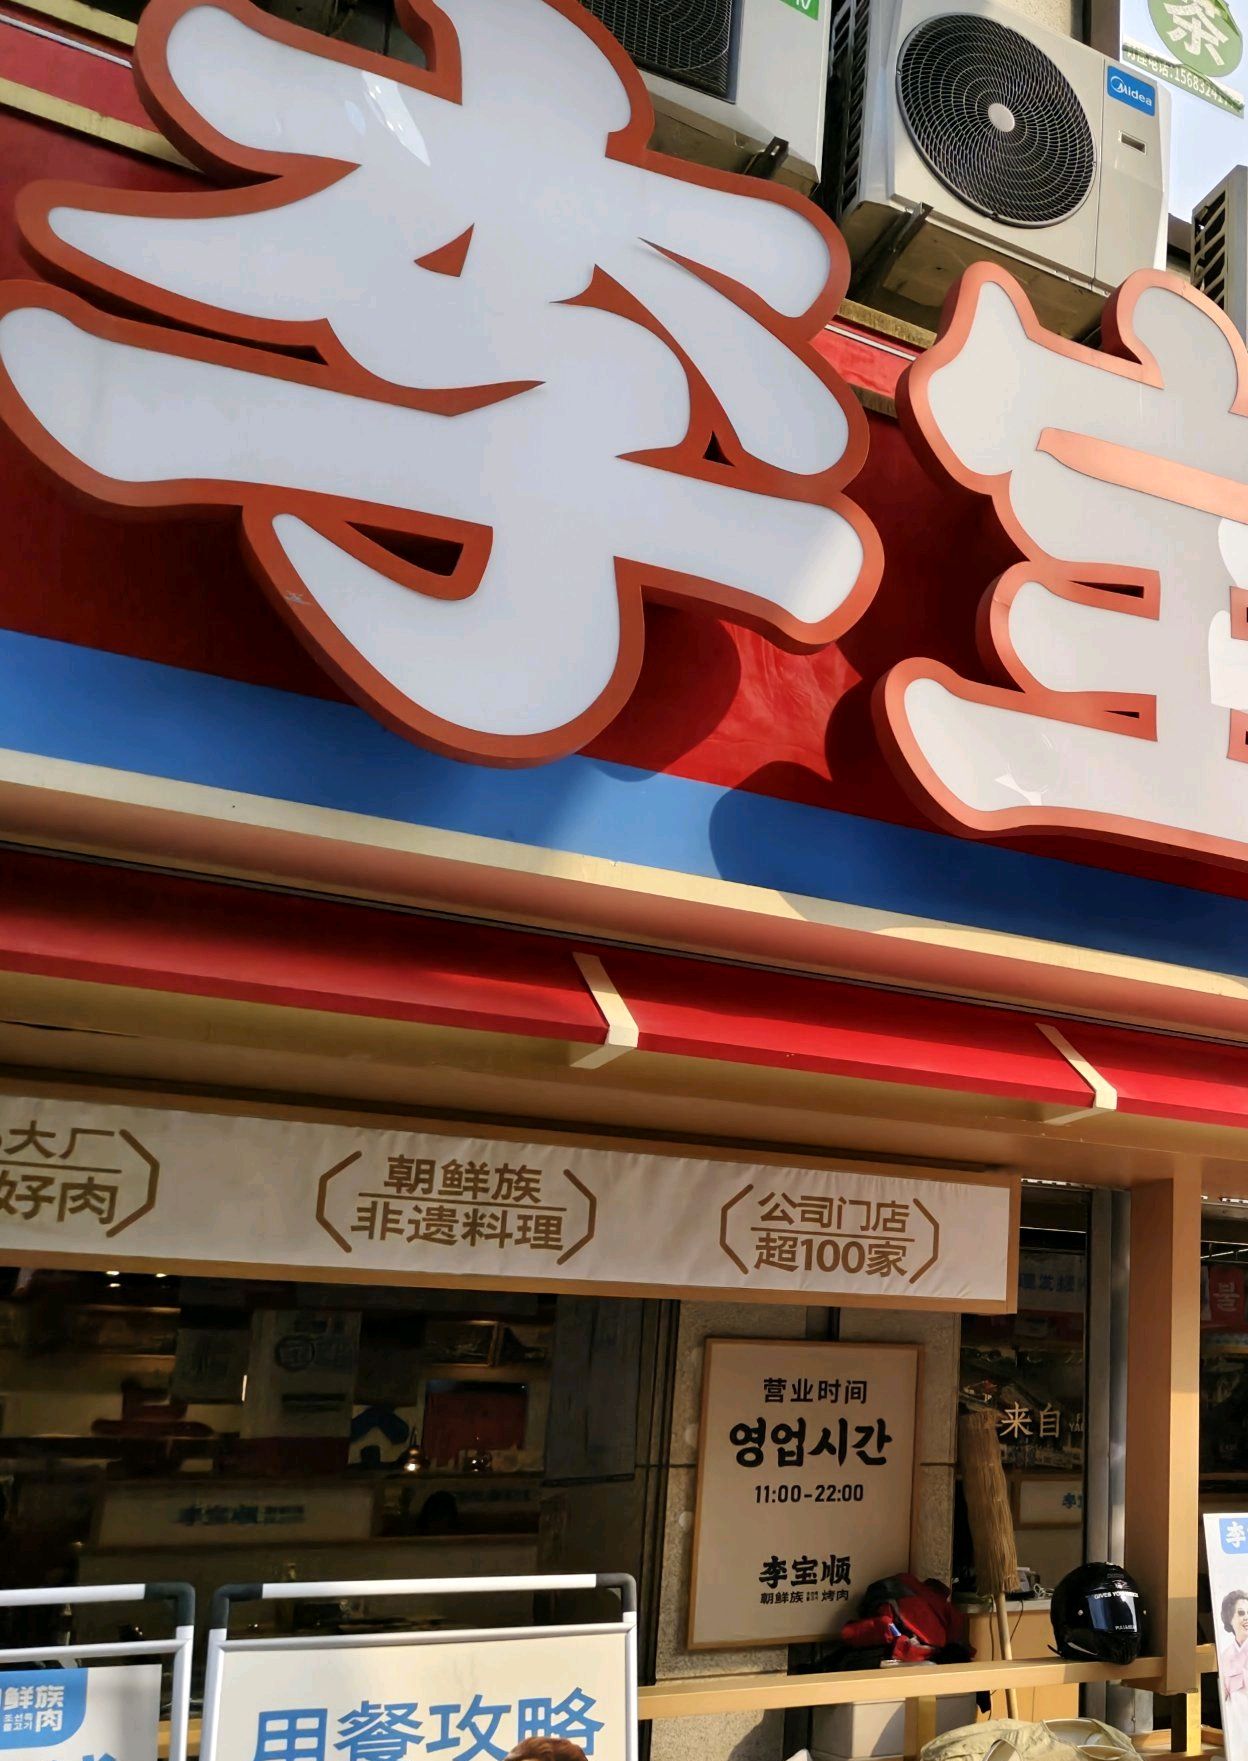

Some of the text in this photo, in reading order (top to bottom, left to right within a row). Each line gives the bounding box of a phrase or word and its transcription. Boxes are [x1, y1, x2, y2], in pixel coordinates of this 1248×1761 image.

[1110, 76, 1153, 106] Midea
[0, 1120, 115, 1159] 大厂
[384, 1154, 543, 1204] 朝鲜族
[351, 1200, 564, 1251] 非遗料理
[757, 1191, 910, 1233] 公司门店
[754, 1232, 908, 1277] 超100家
[763, 1378, 868, 1404] 营业时间
[1000, 1401, 1060, 1438] 来自
[729, 1417, 893, 1468] 영업시간
[755, 1484, 864, 1503] 11:00-22:00
[759, 1555, 851, 1588] 李宝顺
[0, 1685, 65, 1711] 鲜族
[35, 1710, 63, 1732] 肉
